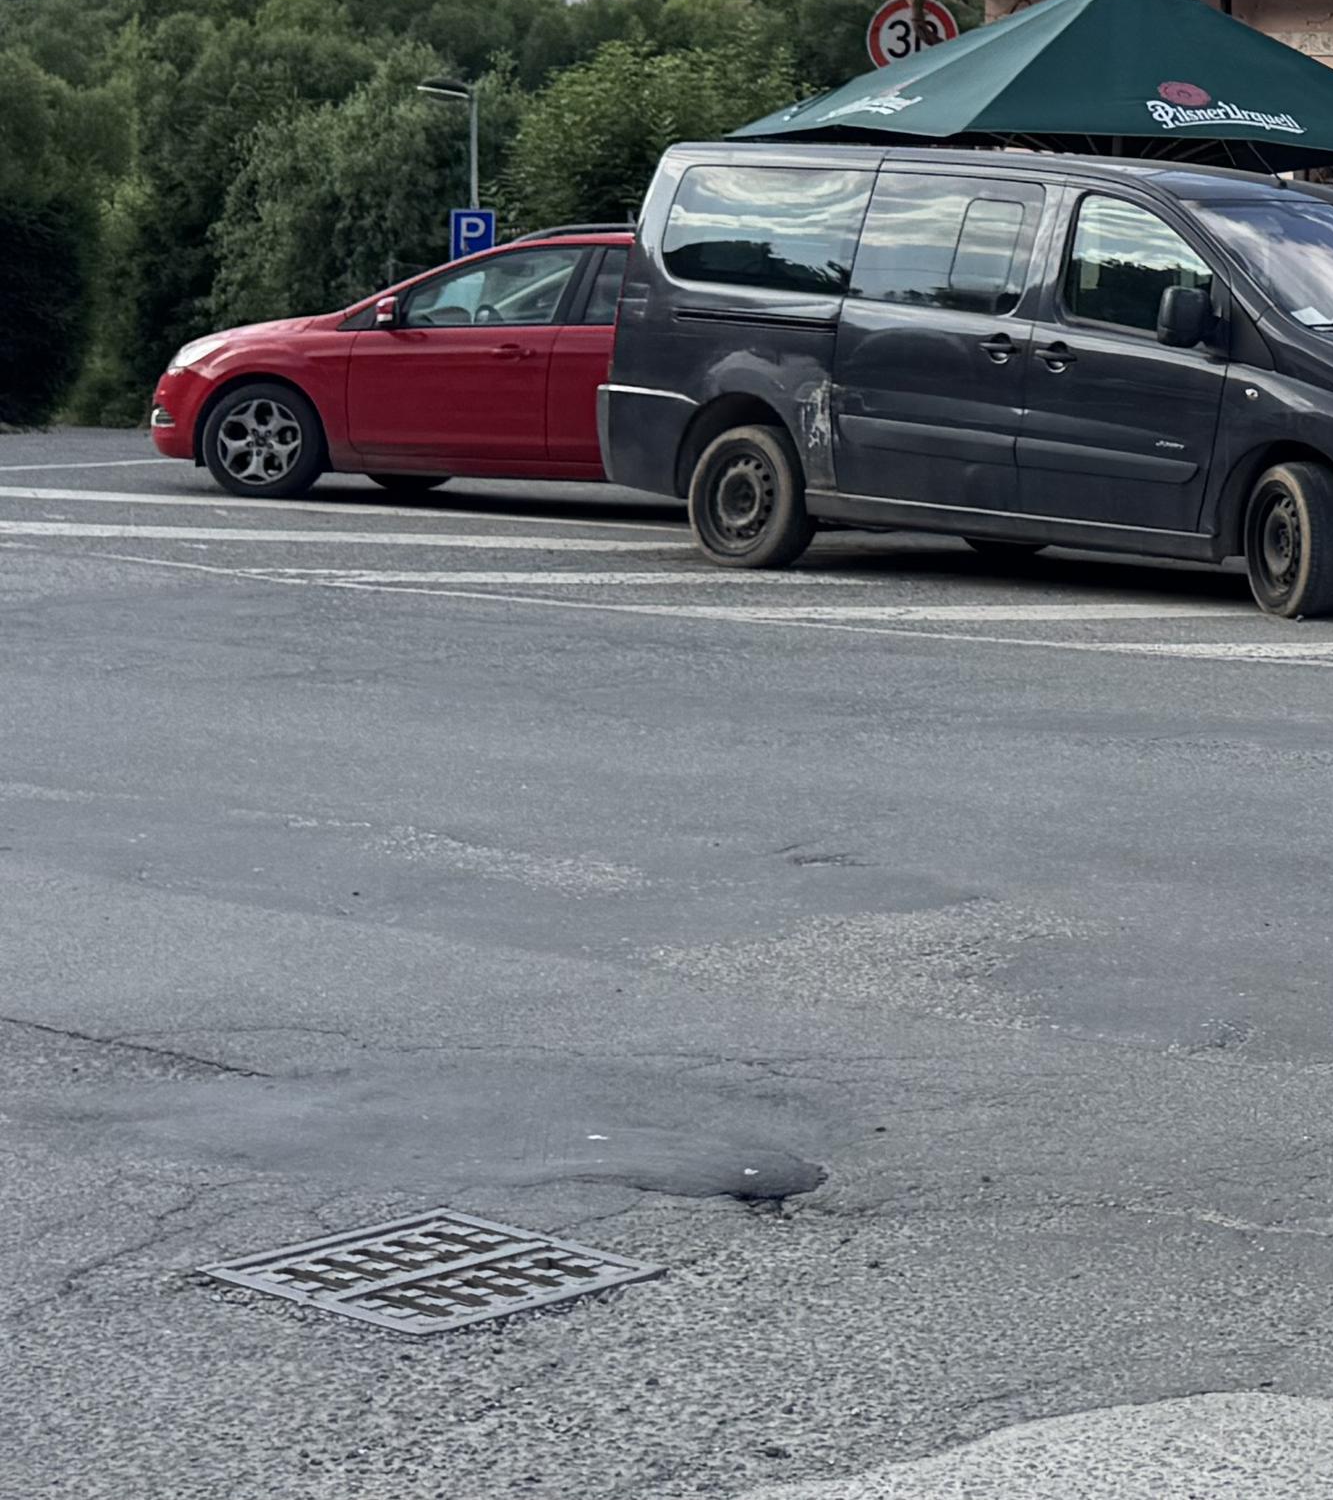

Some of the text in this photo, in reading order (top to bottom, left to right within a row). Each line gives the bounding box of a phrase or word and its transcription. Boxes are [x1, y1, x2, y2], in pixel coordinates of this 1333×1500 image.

[1146, 100, 1304, 134] Pilsner Urquell
[460, 217, 486, 255] P
